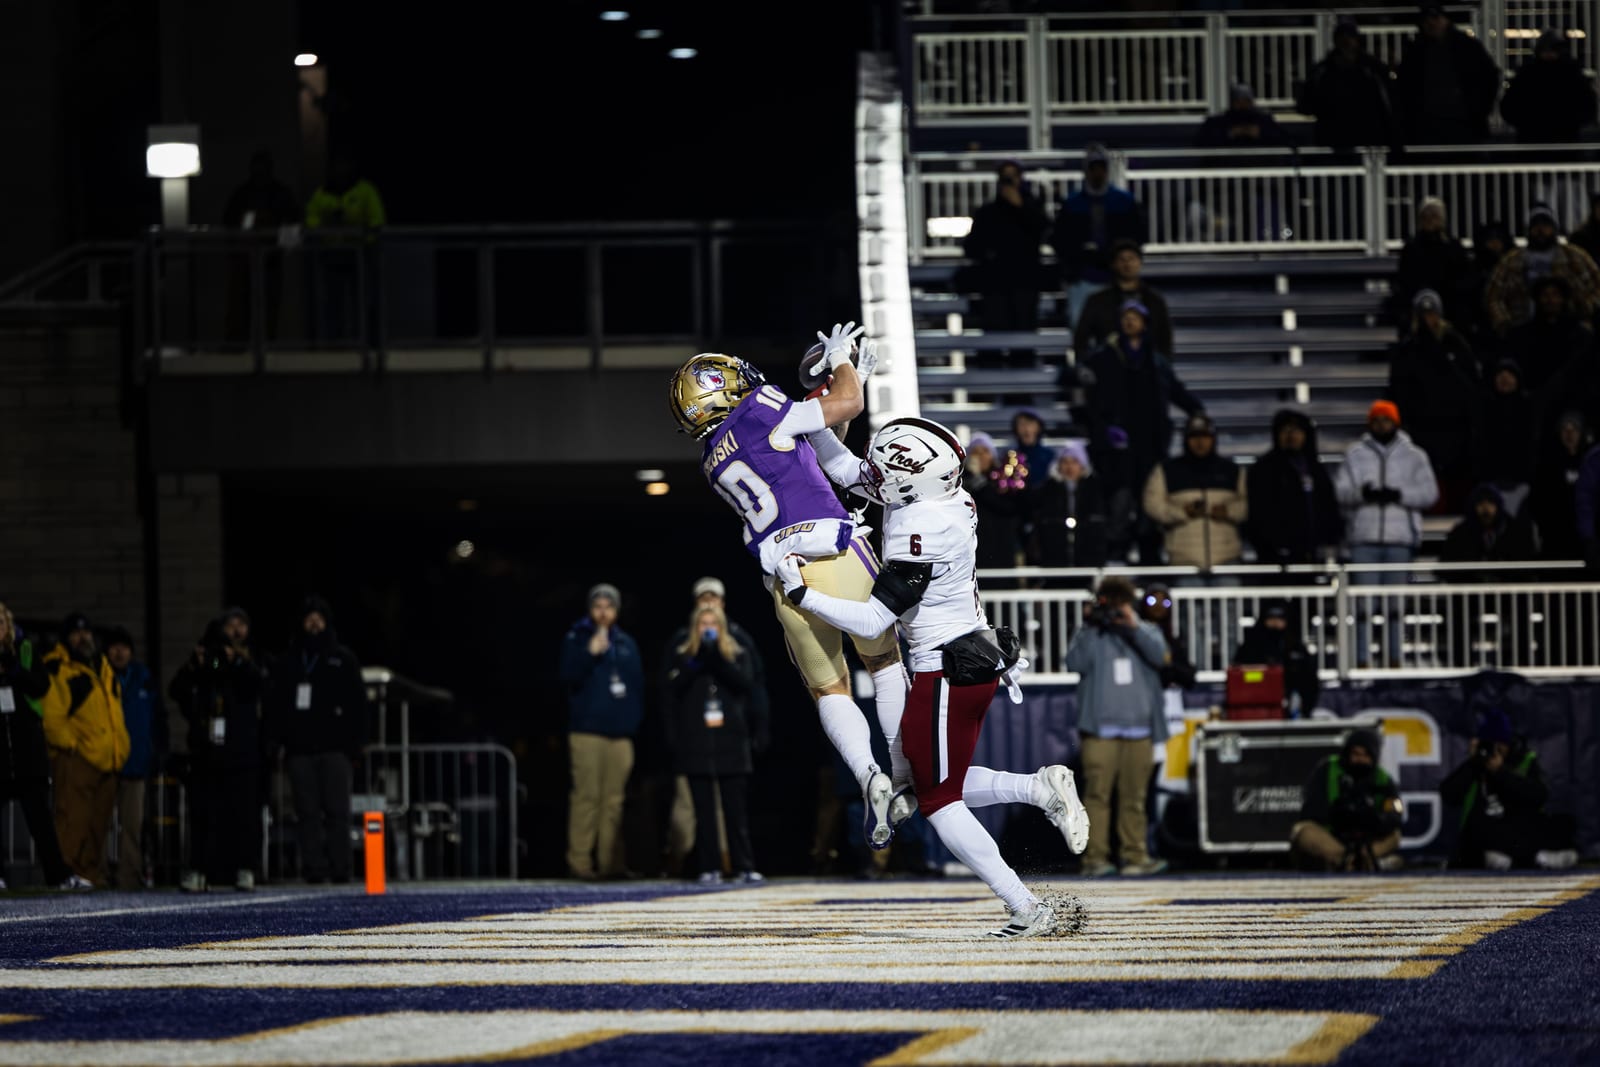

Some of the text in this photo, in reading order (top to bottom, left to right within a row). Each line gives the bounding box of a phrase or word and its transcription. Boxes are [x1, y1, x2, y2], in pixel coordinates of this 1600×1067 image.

[756, 384, 788, 412] 10
[887, 443, 925, 475] Troy
[774, 522, 817, 544] JMU
[910, 534, 922, 556] 6
